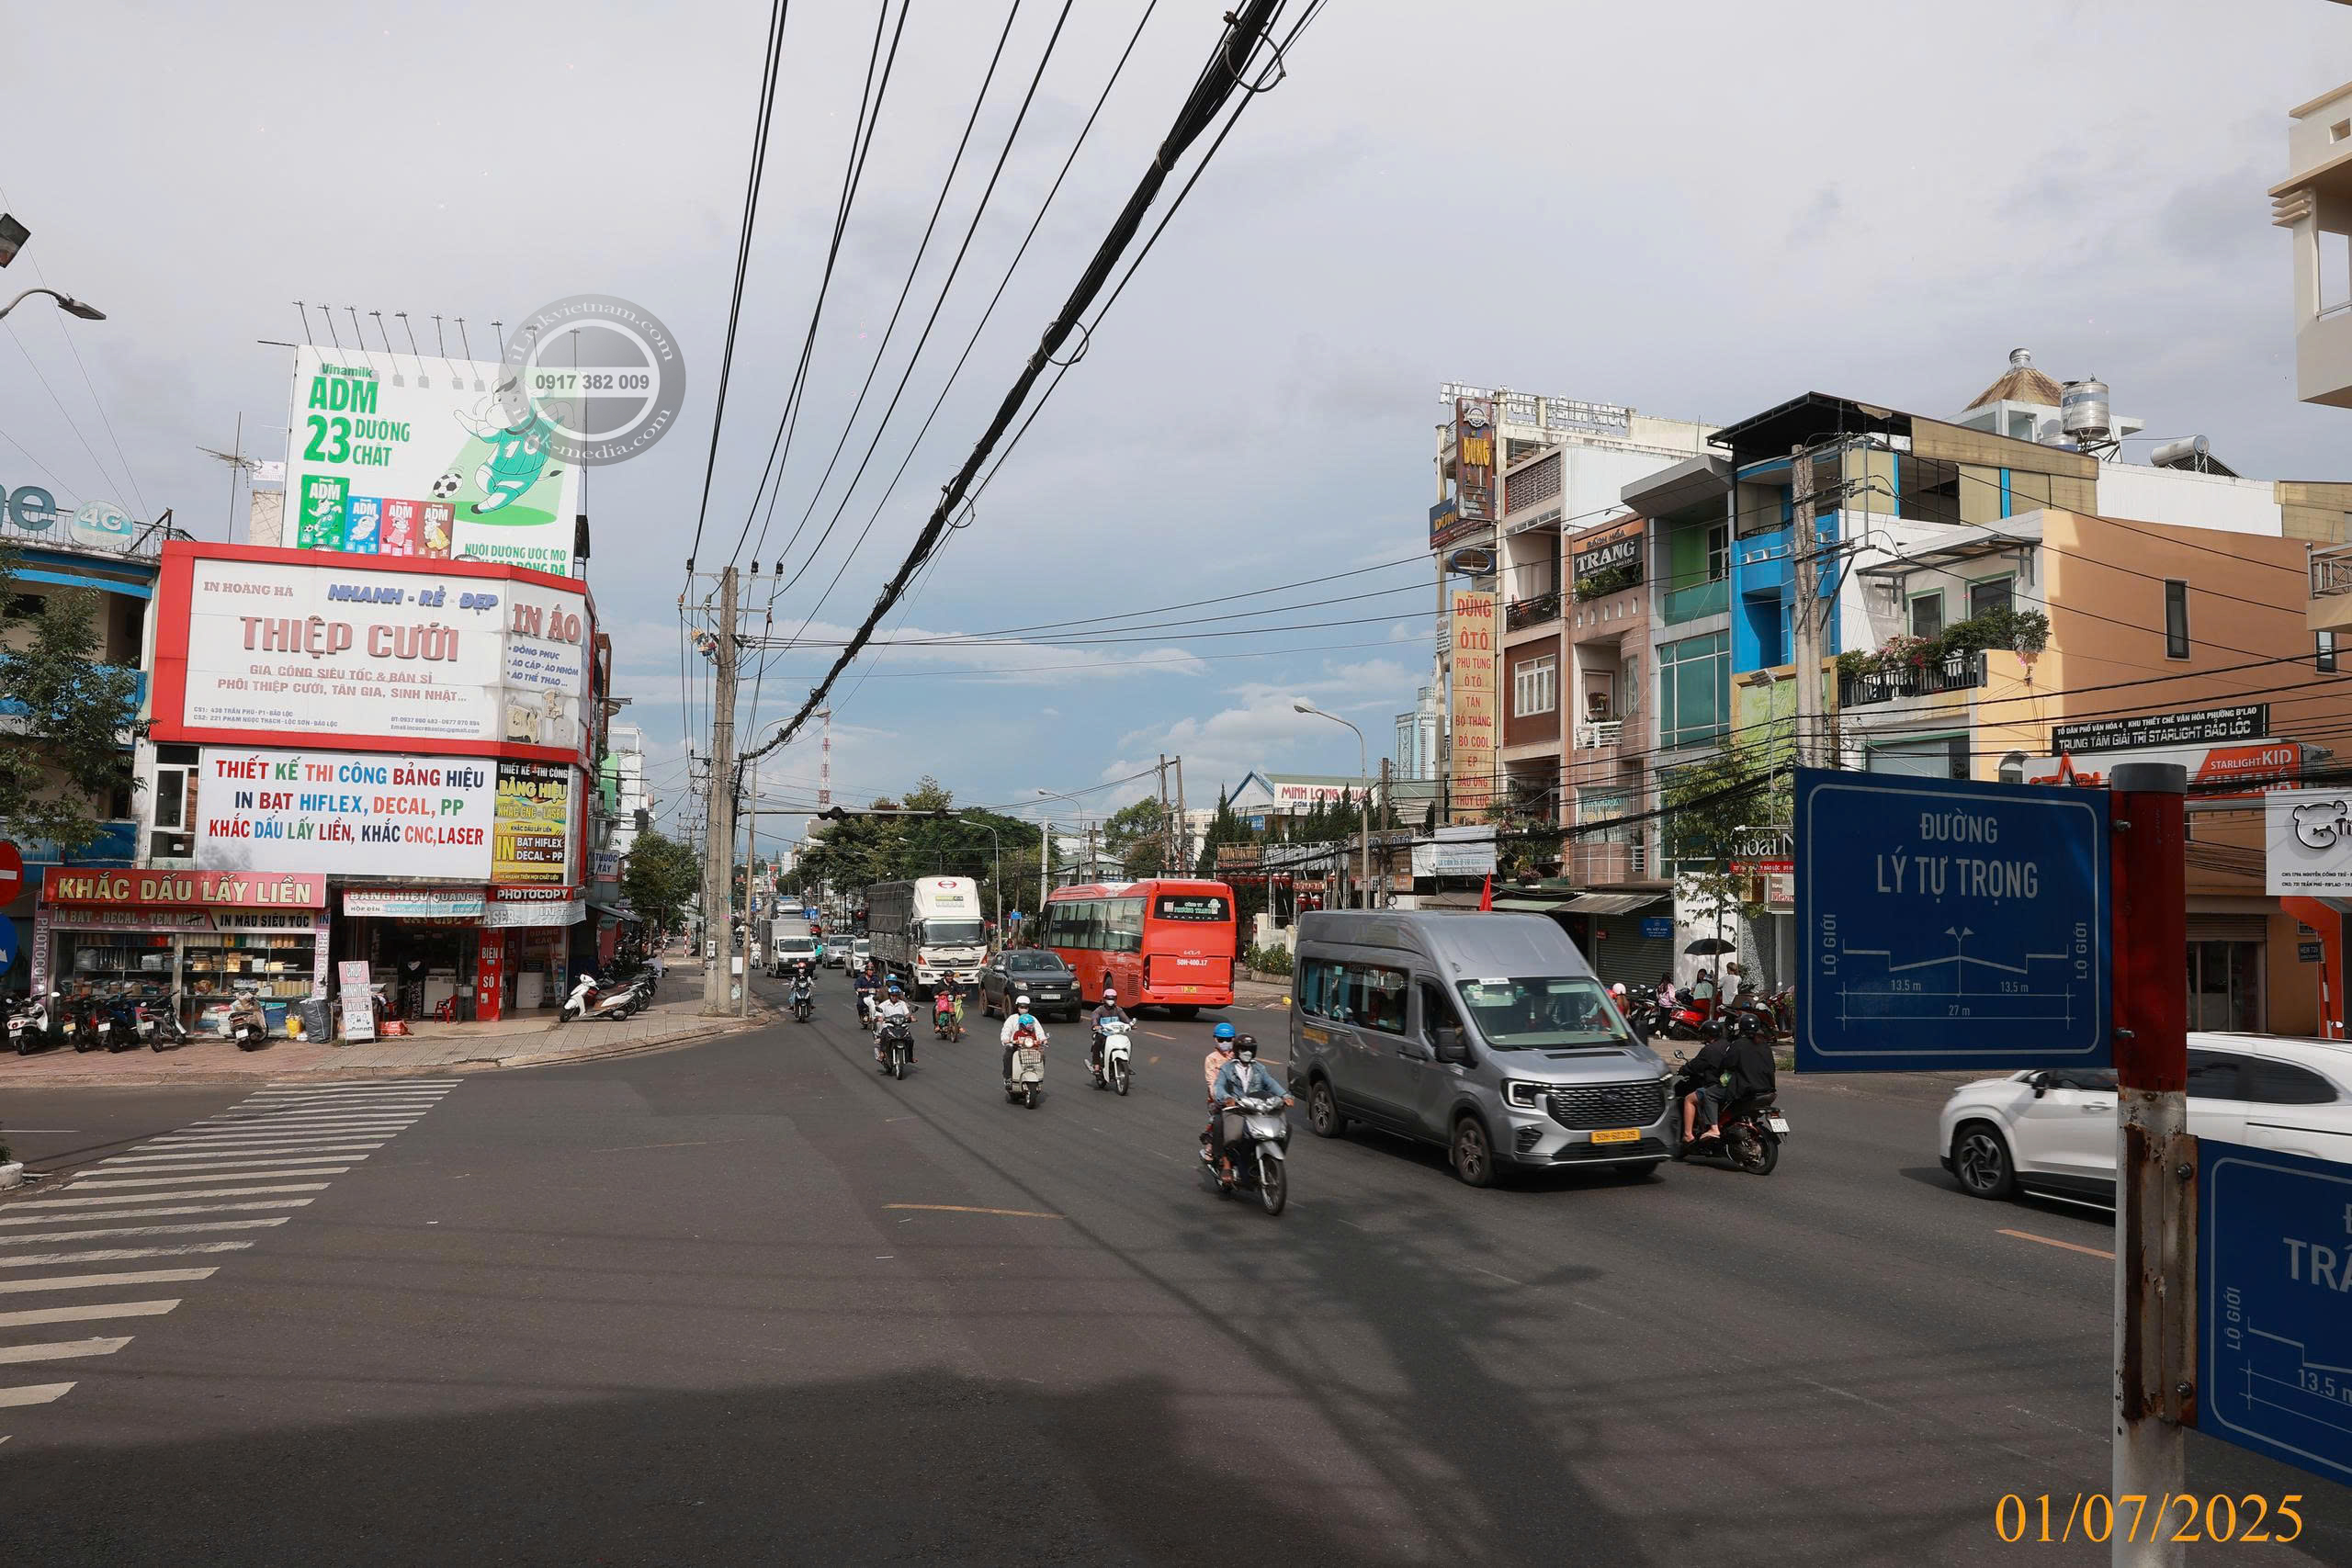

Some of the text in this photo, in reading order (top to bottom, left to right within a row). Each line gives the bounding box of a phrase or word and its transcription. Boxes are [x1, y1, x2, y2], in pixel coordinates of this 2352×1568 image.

[322, 363, 373, 378] Vinamilk
[308, 376, 379, 414] ADM
[303, 414, 352, 464] 23
[355, 418, 411, 443] DƯỠNG
[352, 442, 392, 467] CHẤT
[309, 482, 341, 501] ADM
[80, 507, 122, 530] 4G
[353, 502, 377, 515] ADM
[389, 504, 413, 519] ADM
[424, 507, 448, 522] ADM
[1576, 540, 1636, 573] TRANG
[203, 581, 220, 593] IN
[327, 583, 499, 615] NHANH RẺ ĐẸP
[1457, 592, 1492, 618] DŨNG
[512, 603, 543, 637] IN
[240, 614, 459, 662] THIỆP CƯỚI
[250, 664, 386, 682] GIA CÔNG SIÊU TỐC &
[1455, 654, 1491, 671] PHỤ TÙNG
[217, 678, 421, 700] PHÔI THIỆP CƯỚI, TÂN GIA, SINH
[2057, 725, 2065, 735] TỔ
[2066, 726, 2078, 735] DÂN
[2079, 724, 2092, 733] PHỐ
[2092, 723, 2104, 732] VĂN
[2105, 722, 2118, 730] HÓA
[2128, 719, 2141, 728] KHU
[2143, 716, 2161, 727] THIẾT
[2162, 714, 2175, 725] CHẾ
[2177, 713, 2190, 723] VĂN
[2191, 711, 2205, 722] HÓA
[2207, 708, 2234, 720] PHƯỜNG
[2059, 716, 2251, 750] TRUNG TÂM GIẢI TRÍ STARLIGHT BẢO LỘC
[1471, 736, 1490, 749] COOL
[500, 762, 568, 779] THIẾT KẾ THI CÔNG
[2211, 749, 2292, 770] STARLIGHT KID
[215, 754, 484, 791] THIẾT KẾ THI CÔNG BẢNG HIỆU
[499, 775, 568, 804] BẢNG HIỆU
[1282, 786, 1339, 801] MINH LONG
[234, 791, 464, 818] IN BẠT HIFLEX, DECAL, PP
[209, 812, 251, 838] KHẮC
[254, 813, 284, 840] DẤU
[288, 816, 315, 840] LẤY
[319, 816, 356, 845] LIỀN,
[361, 818, 401, 842] KHẮC
[1919, 807, 1998, 844] ĐƯỜNG
[496, 834, 515, 862] IN
[516, 837, 562, 850] BẠT HIFLEX
[516, 851, 563, 862] DECAL PP
[58, 871, 312, 904] KHẮC DẤU LẤY LIỀN
[1877, 845, 2039, 906] LÝ TỰ TRỌNG
[496, 888, 569, 900] PHOTOCOPY
[53, 909, 66, 921] IN
[103, 911, 138, 925] DECAL
[149, 912, 172, 925] TEM
[220, 914, 231, 926] IN
[1820, 914, 1839, 976] LỘ GIỚI
[2073, 921, 2090, 979] LỘ GIỚI
[1913, 983, 1921, 992] m
[2020, 984, 2029, 993] m
[1949, 1005, 1970, 1017] 27 m
[2223, 1286, 2244, 1350] LỘ GIỚI
[2298, 1369, 2335, 1397] 13.5
